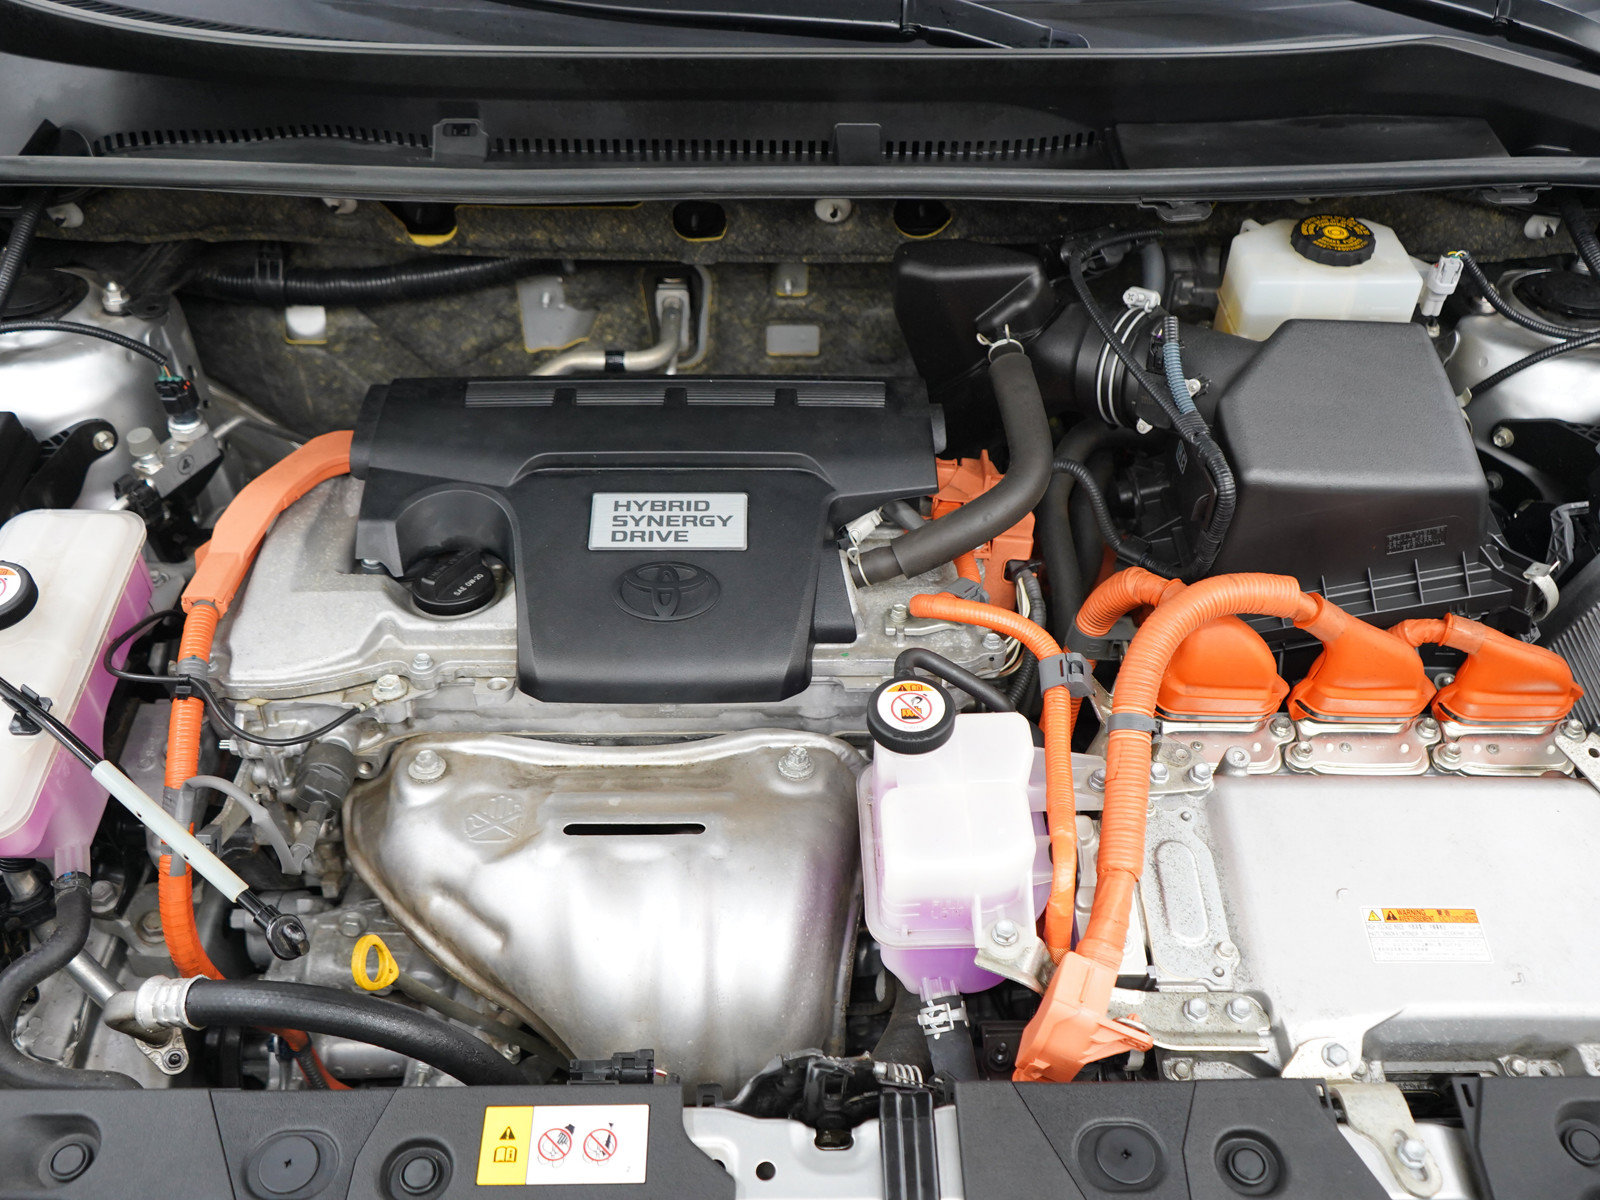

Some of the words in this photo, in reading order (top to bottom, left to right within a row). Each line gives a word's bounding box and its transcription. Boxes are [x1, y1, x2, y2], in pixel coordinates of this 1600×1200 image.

[613, 500, 710, 511] HYBRID
[612, 515, 733, 527] SYNERGY
[611, 530, 689, 542] DRIVE
[453, 585, 467, 596] SAE
[465, 573, 484, 587] 0W-20
[1396, 908, 1426, 916] WARNING
